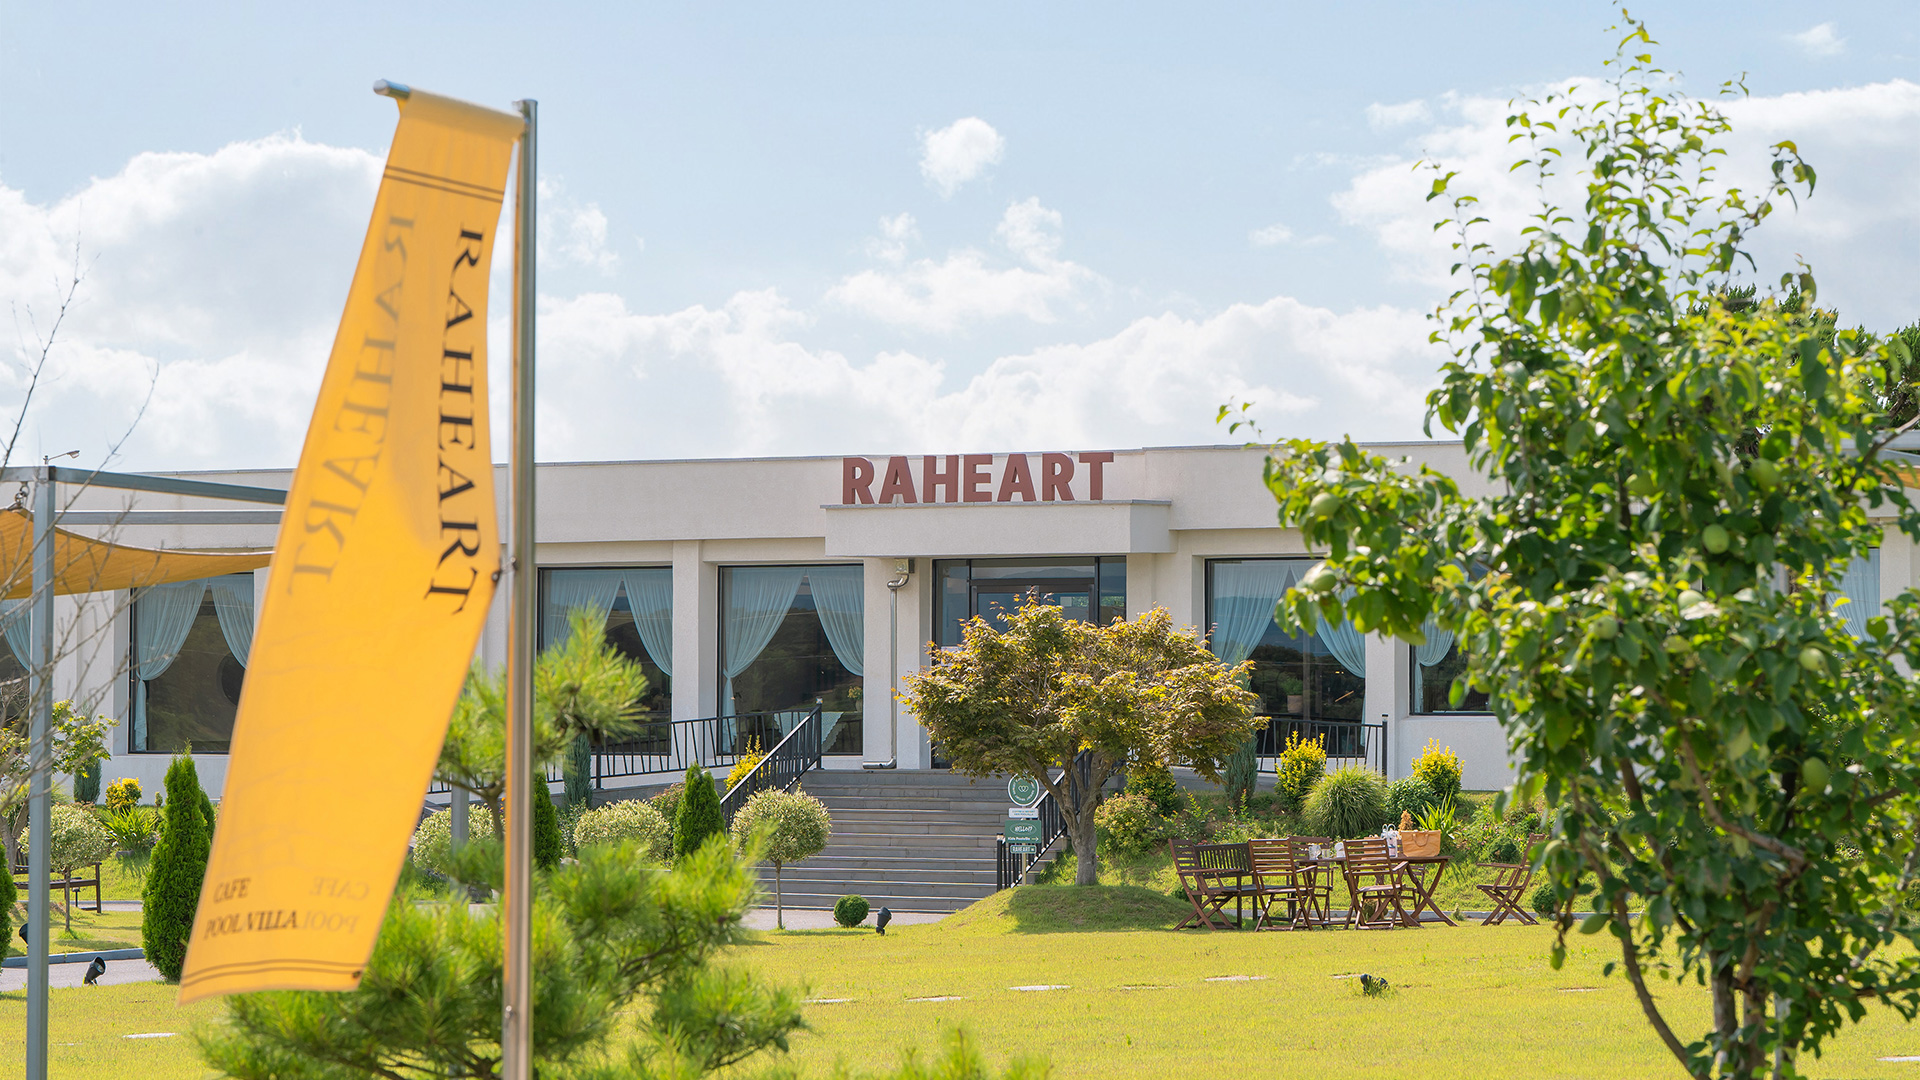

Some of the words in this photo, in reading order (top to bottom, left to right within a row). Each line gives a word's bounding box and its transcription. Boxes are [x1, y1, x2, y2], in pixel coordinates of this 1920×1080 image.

[424, 222, 487, 616] RAHEART
[842, 451, 1114, 505] RAHEART
[213, 876, 251, 904] CAFE
